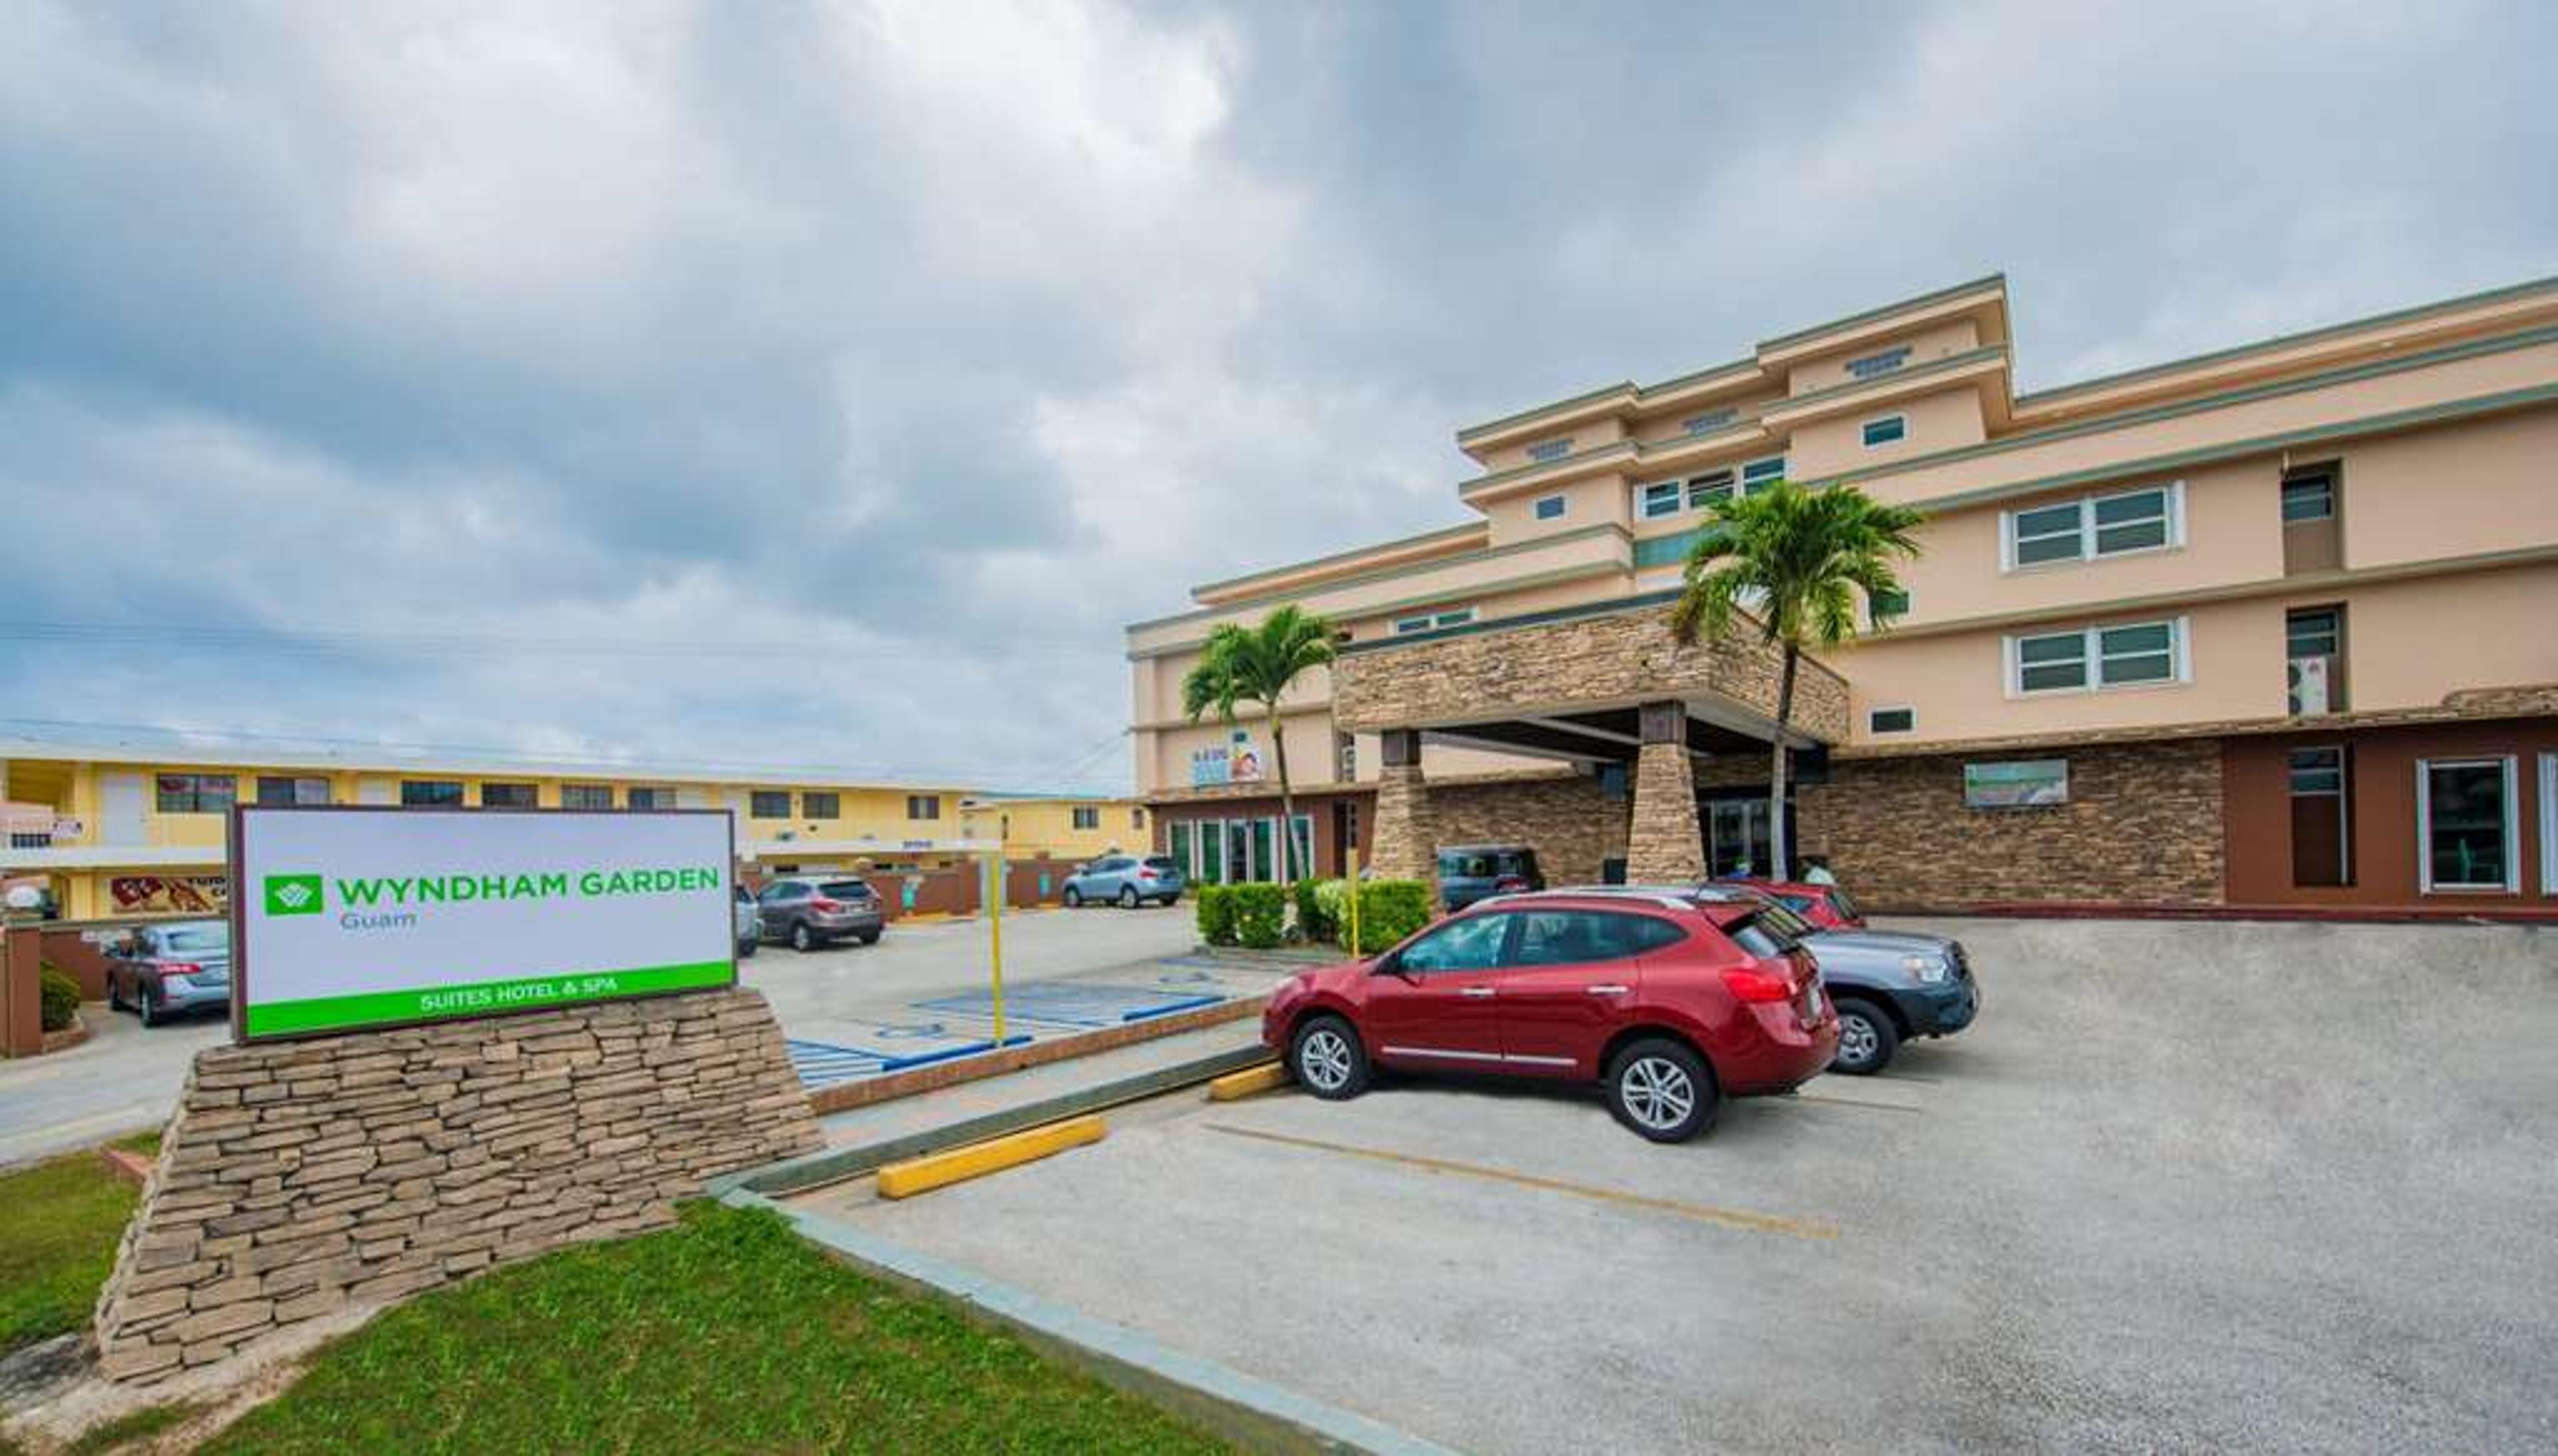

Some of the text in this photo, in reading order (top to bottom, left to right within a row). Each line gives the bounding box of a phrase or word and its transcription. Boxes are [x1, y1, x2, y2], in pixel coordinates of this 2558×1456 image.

[337, 867, 719, 905] WYNDHAM GARDEN
[340, 912, 416, 930] Guam
[420, 978, 618, 1010] SUITES HOTEL & SPA
